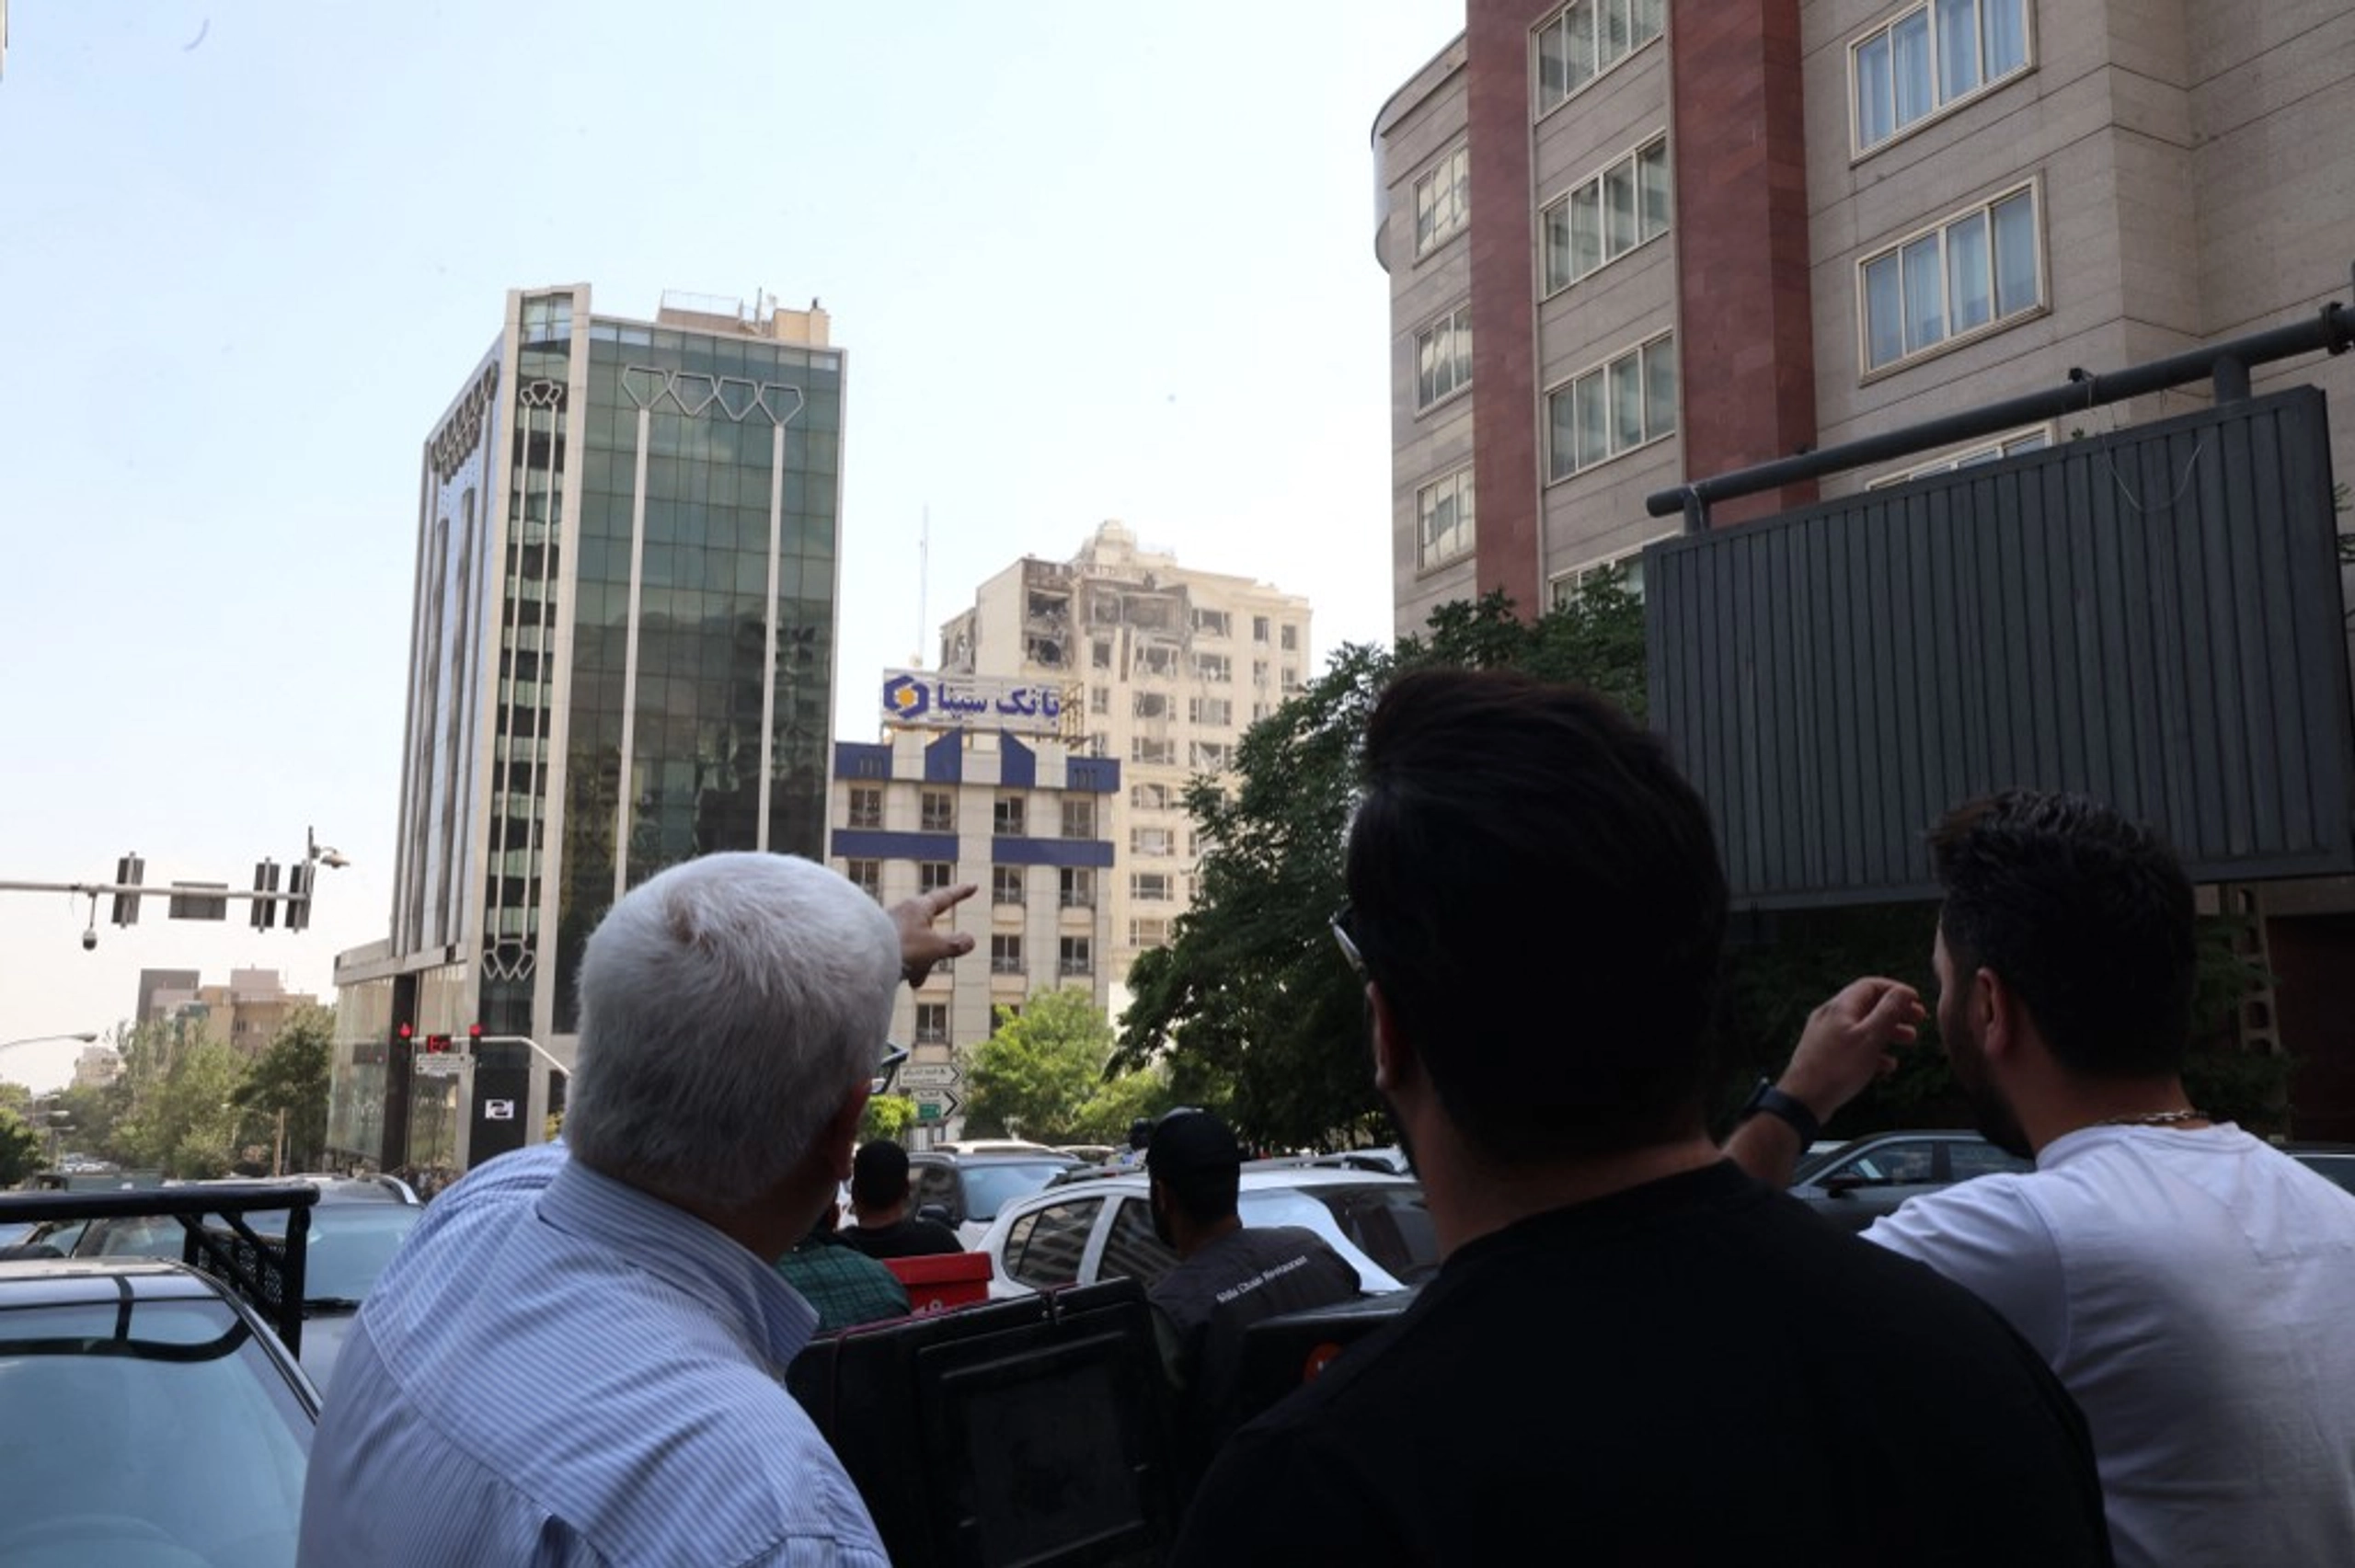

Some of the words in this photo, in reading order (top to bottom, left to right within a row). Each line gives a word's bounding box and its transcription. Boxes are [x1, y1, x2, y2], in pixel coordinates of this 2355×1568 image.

[937, 683, 987, 719] سینا
[995, 689, 1059, 727] بانک
[1262, 1255, 1307, 1280] Restaurant
